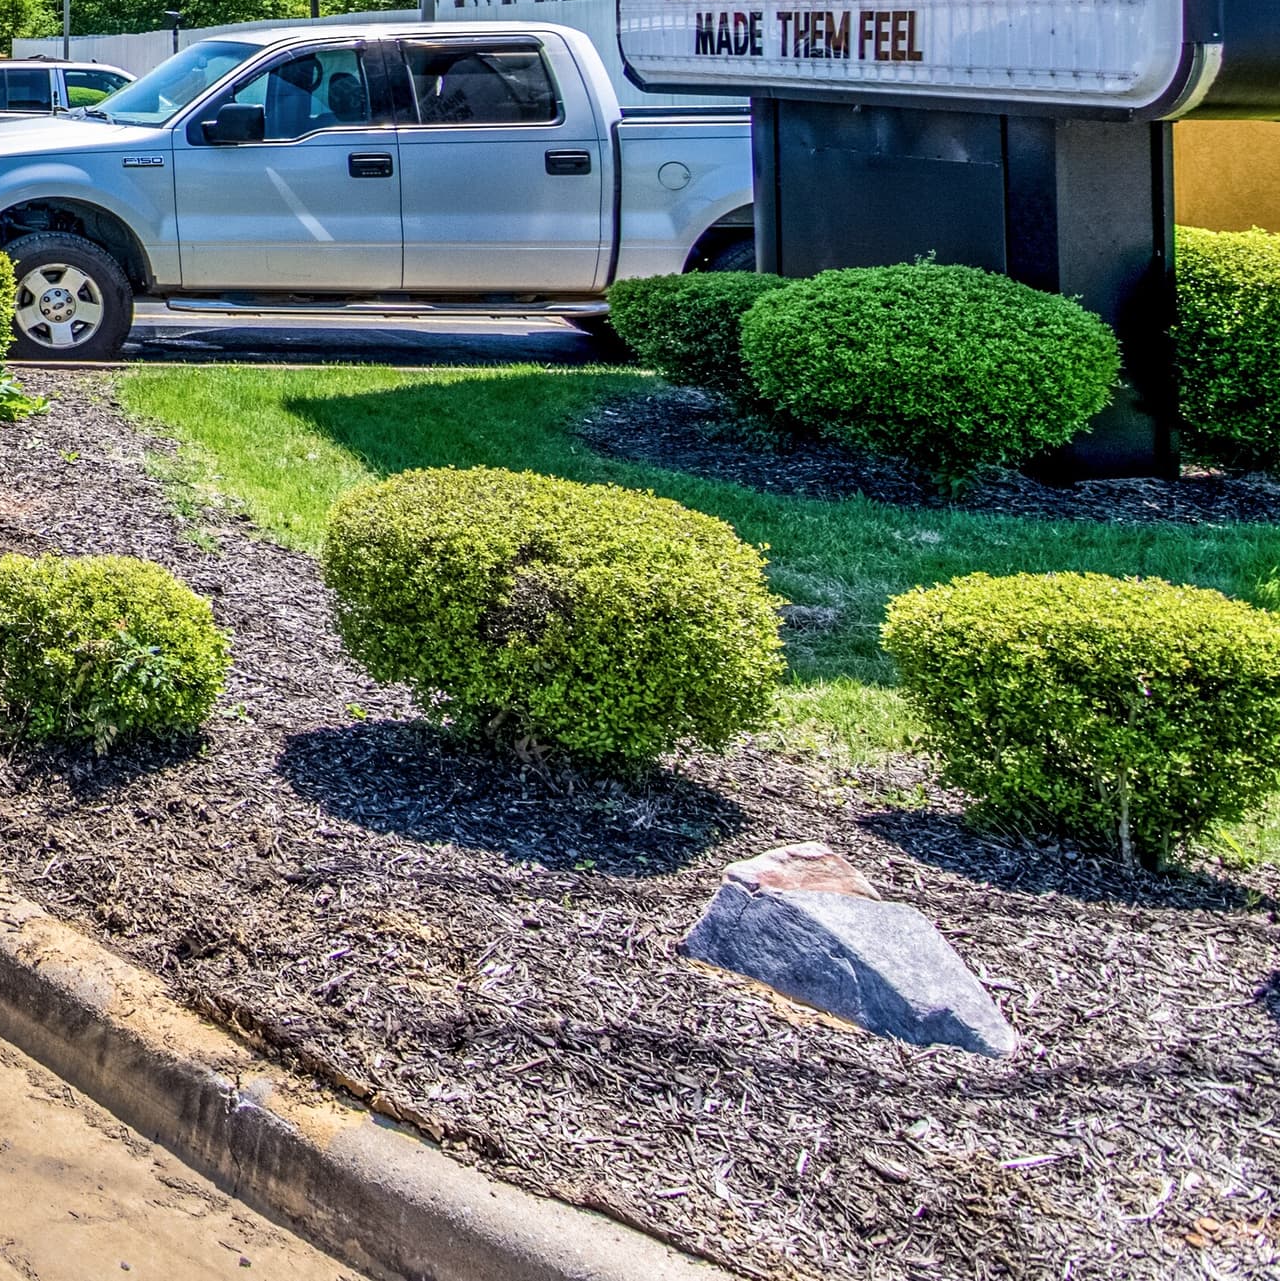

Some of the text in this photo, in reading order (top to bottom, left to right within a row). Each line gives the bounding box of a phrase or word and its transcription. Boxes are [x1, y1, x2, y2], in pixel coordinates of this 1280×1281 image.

[695, 10, 923, 61] MADE THEM FEEL
